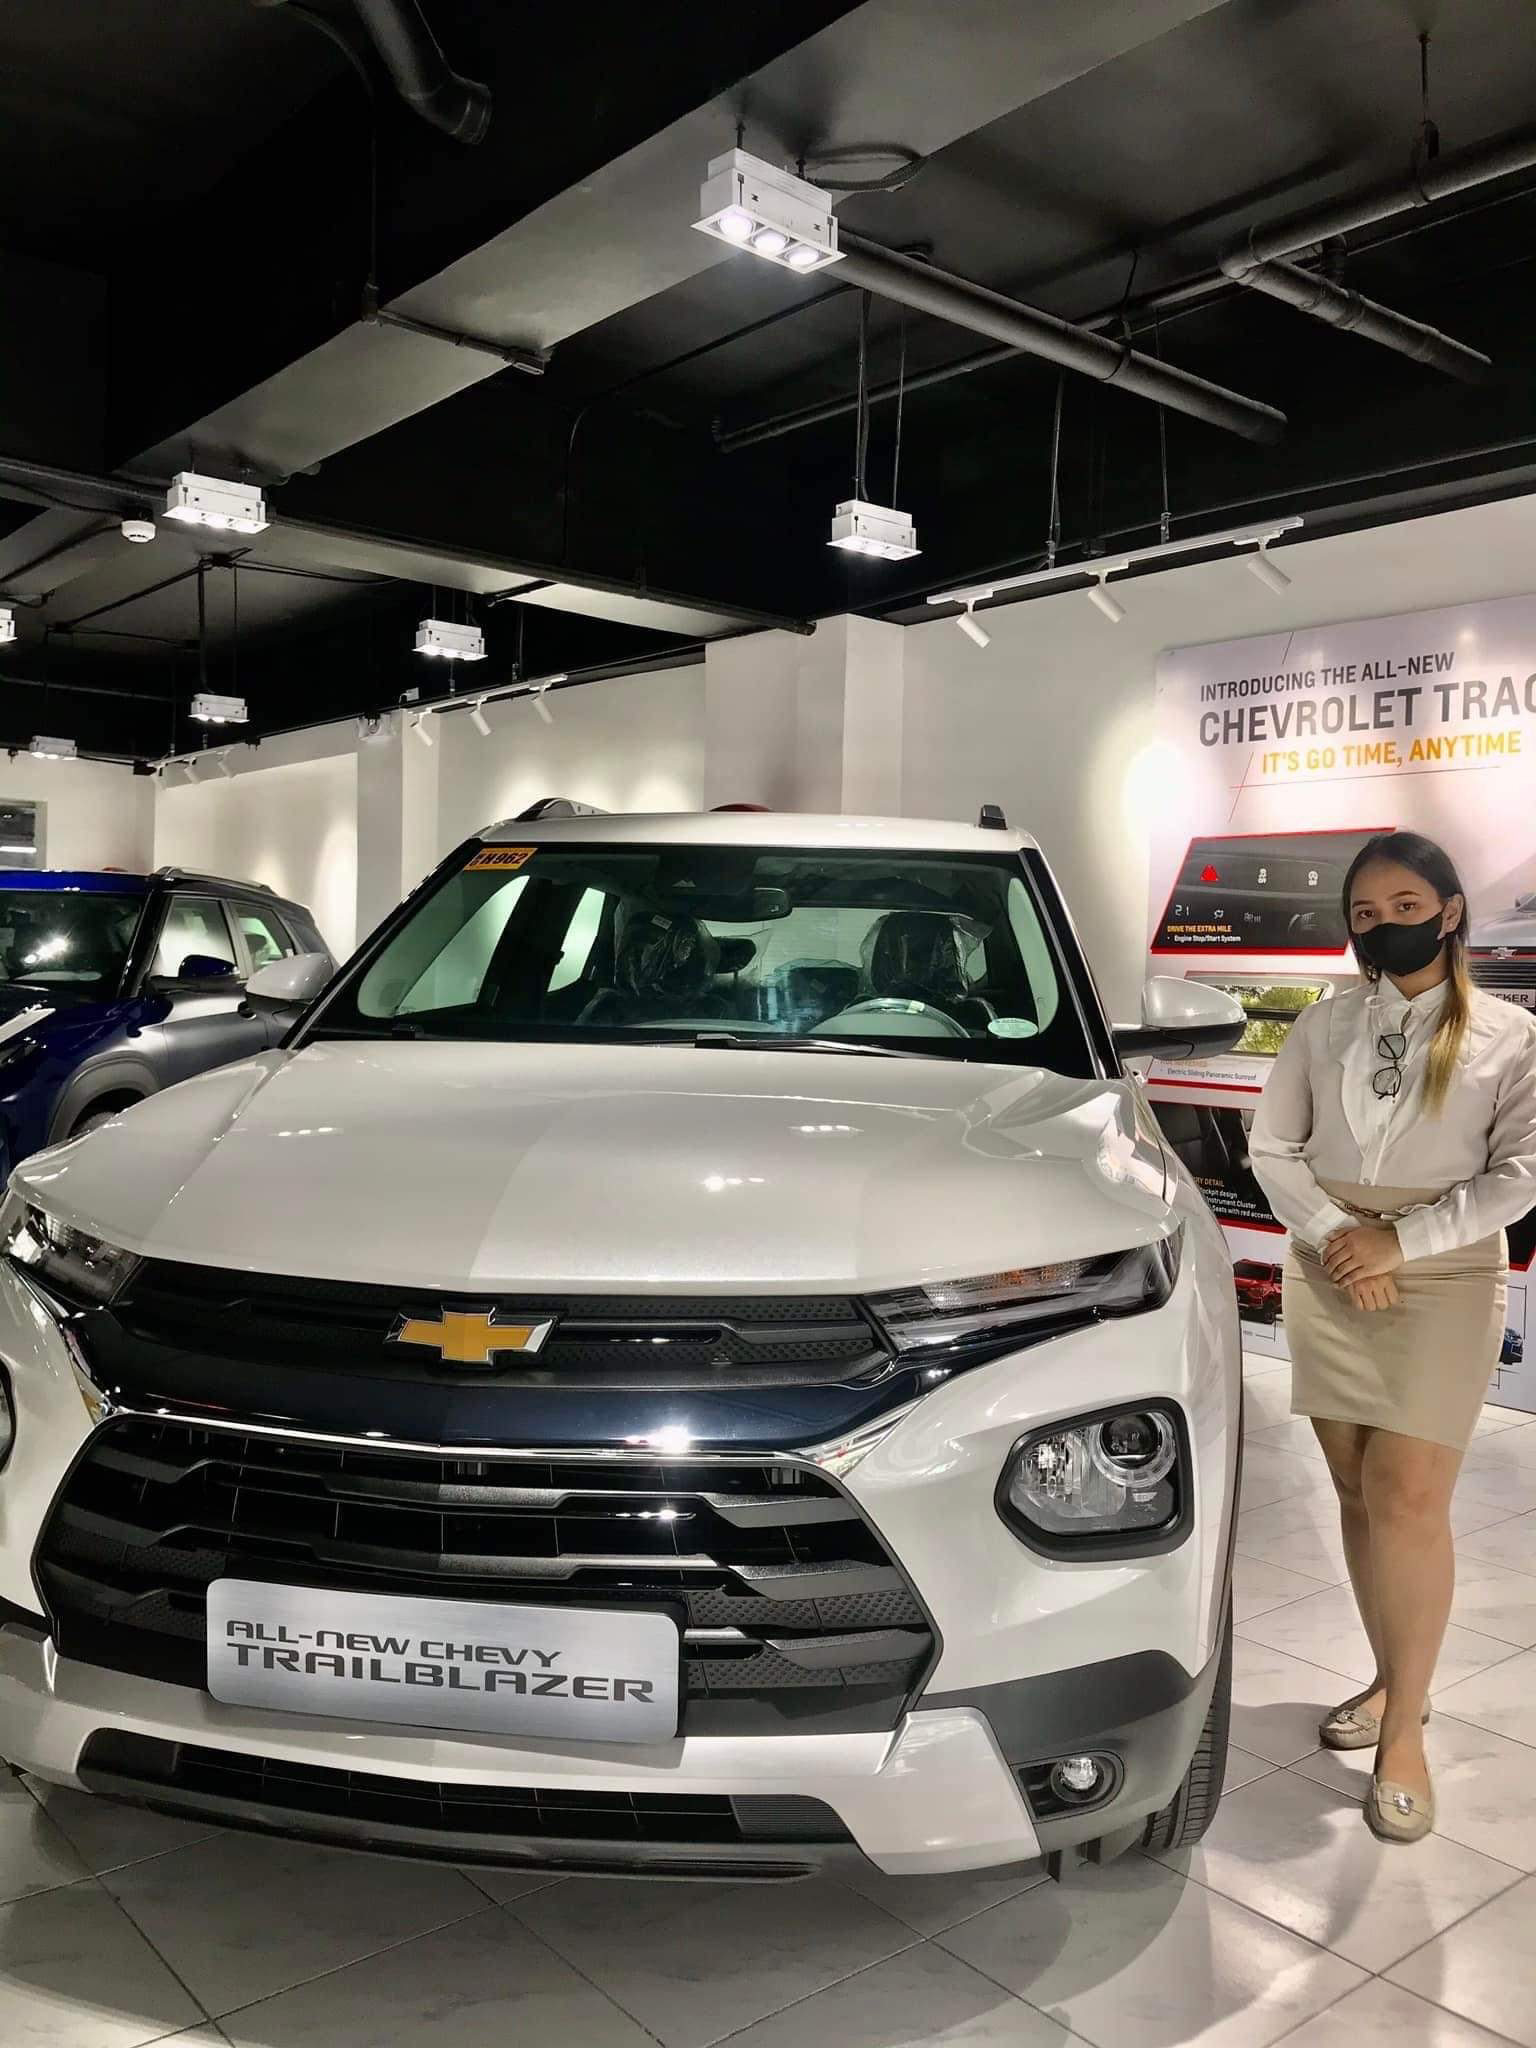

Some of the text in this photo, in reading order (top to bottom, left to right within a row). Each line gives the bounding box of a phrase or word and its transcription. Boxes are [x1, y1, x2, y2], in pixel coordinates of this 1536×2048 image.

[1201, 651, 1455, 702] INTRODUCING THE ALL-NEW
[1200, 687, 1422, 747] CHEVROLET
[1263, 730, 1521, 774] IT'S GO TIME, ANYTIME
[1219, 1191, 1238, 1199] design
[1228, 1208, 1240, 1216] with
[1237, 1200, 1256, 1209] Cluster
[226, 1619, 562, 1668] ALL-NEW CHEVY
[226, 1642, 656, 1704] TRAILBLAZER
